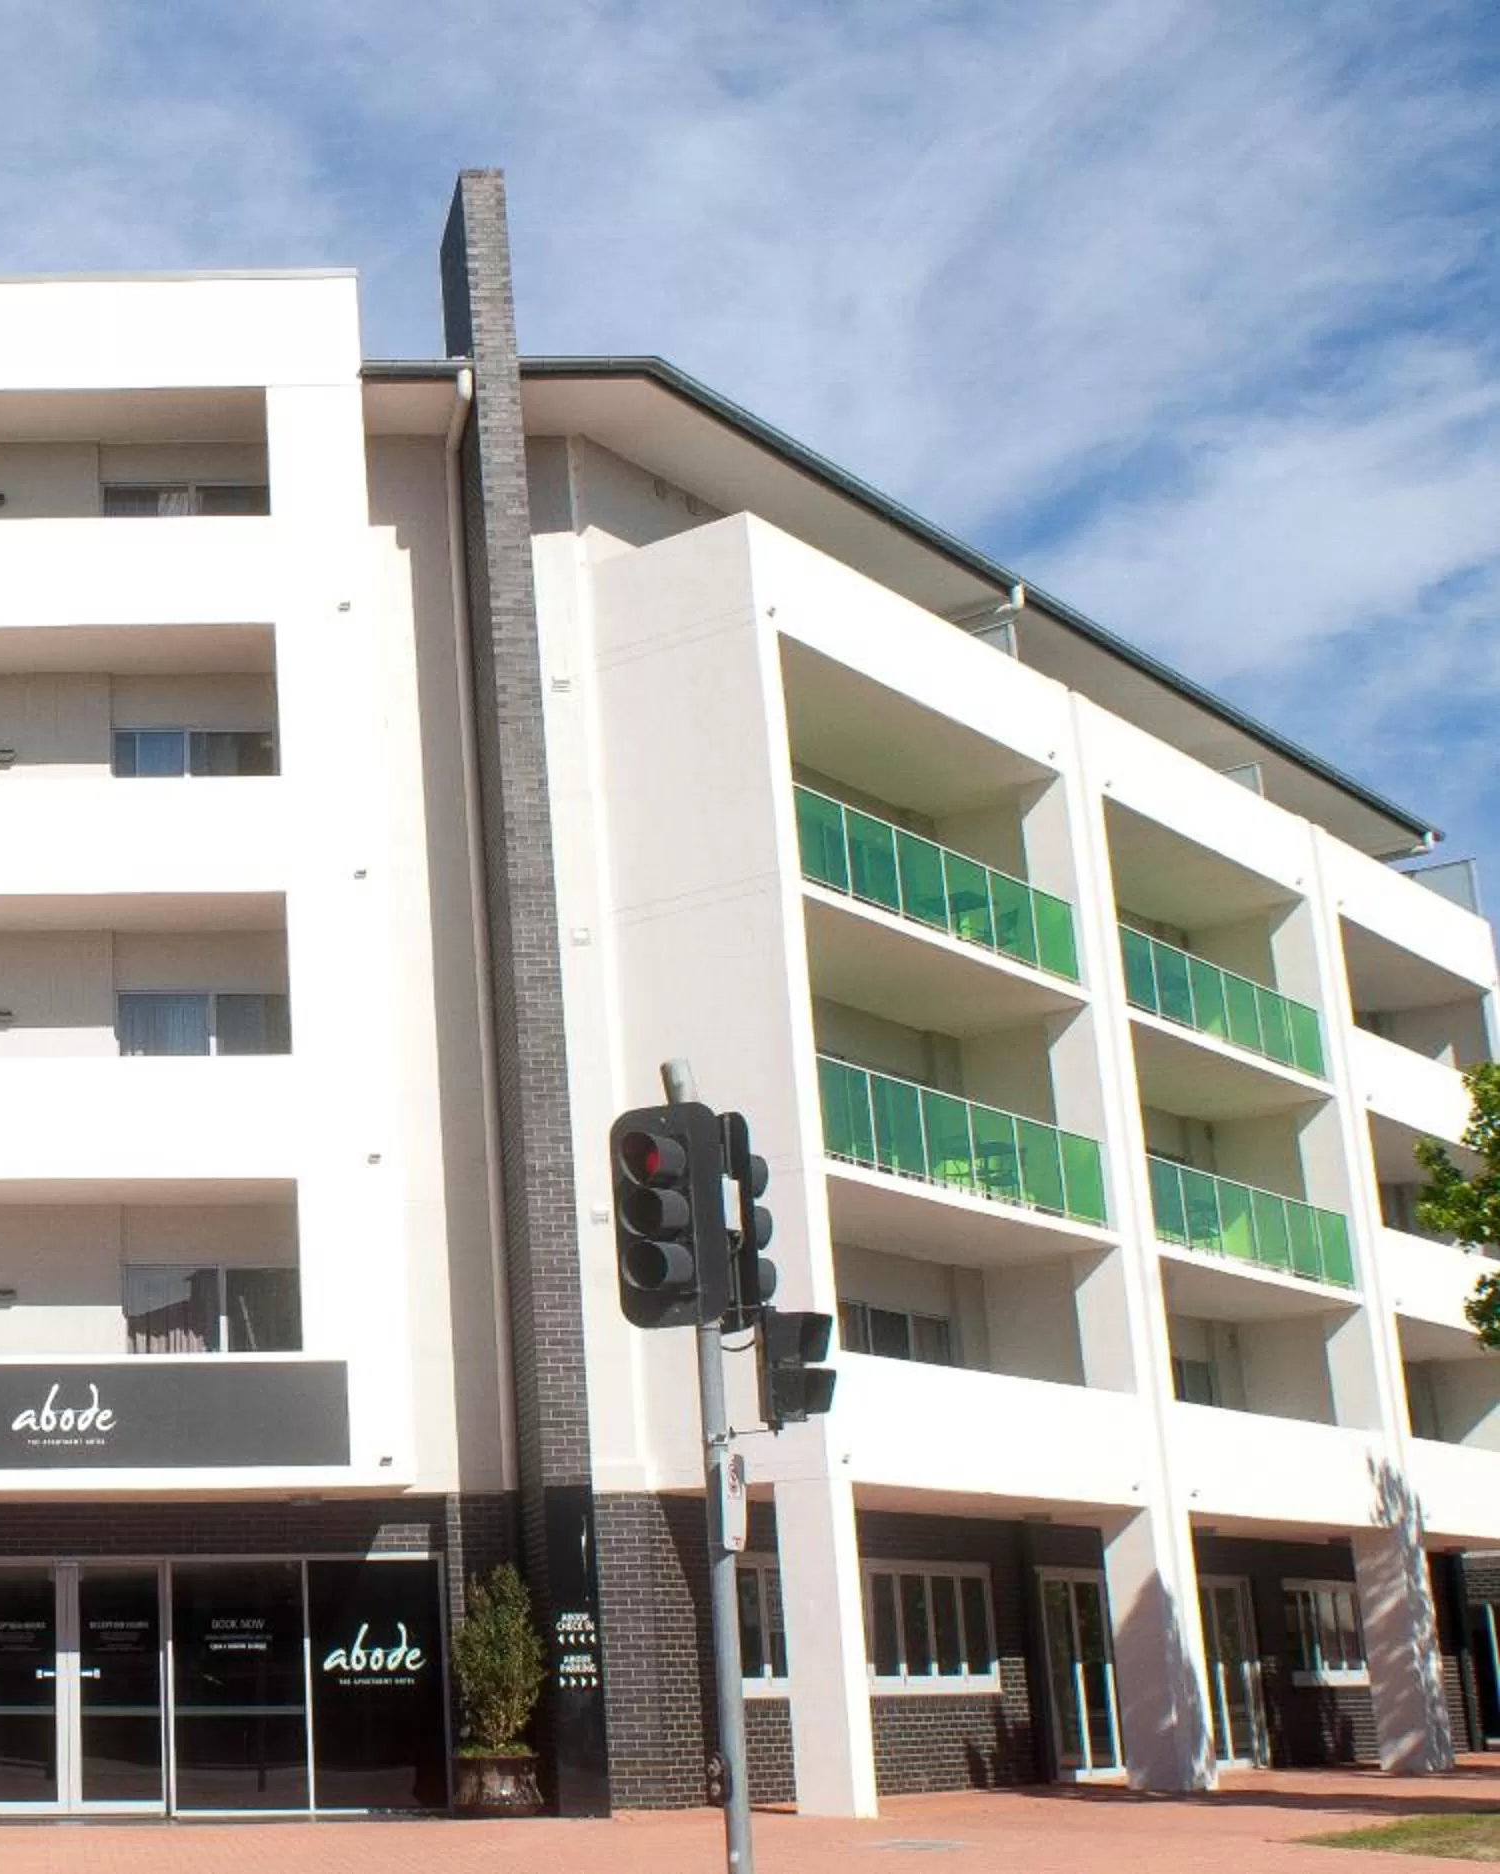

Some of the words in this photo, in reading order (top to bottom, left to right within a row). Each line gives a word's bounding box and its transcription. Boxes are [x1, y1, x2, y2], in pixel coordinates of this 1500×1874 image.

[11, 1383, 117, 1431] abode
[211, 1619, 238, 1629] BOOK
[239, 1619, 266, 1629] NOW
[555, 1621, 582, 1631] CHECK
[585, 1621, 595, 1631] IN
[323, 1622, 426, 1671] abode
[559, 1663, 597, 1673] PARKING
